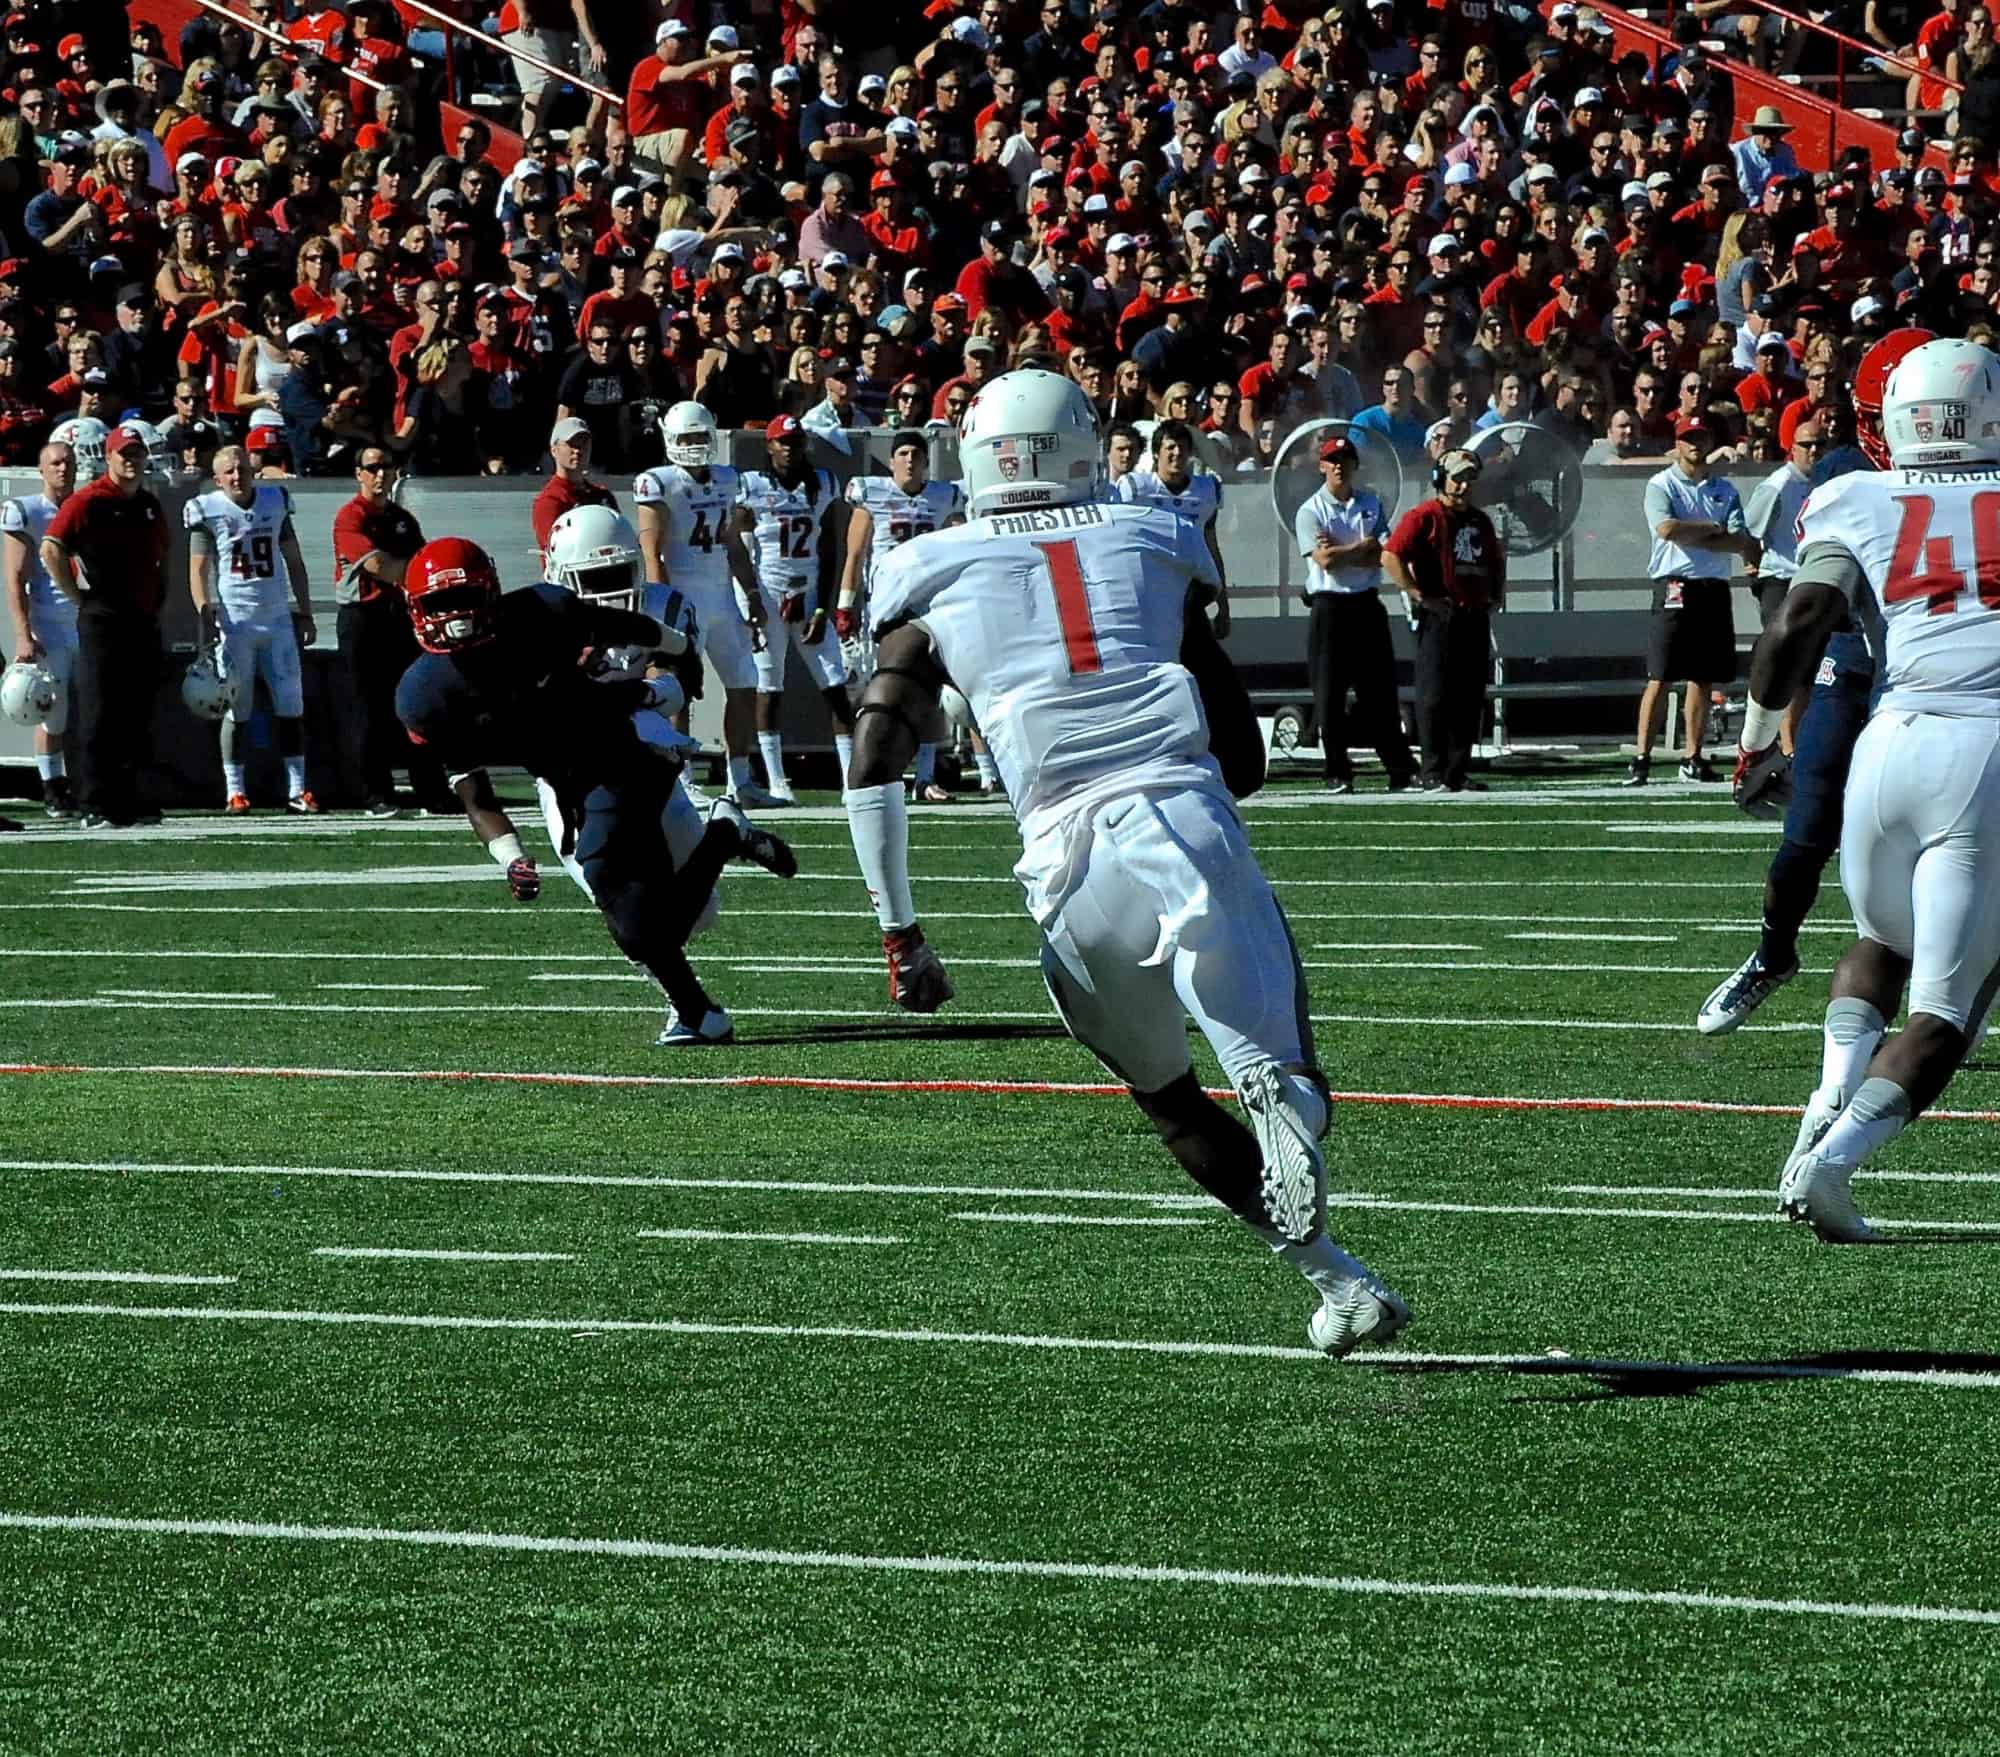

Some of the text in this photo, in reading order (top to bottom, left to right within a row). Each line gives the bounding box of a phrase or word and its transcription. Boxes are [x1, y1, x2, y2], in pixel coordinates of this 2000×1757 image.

[1945, 403, 1968, 418] ESF
[1941, 418, 1966, 441] 40
[1031, 436, 1055, 451] ESF
[1917, 450, 1962, 463] COUGARS
[1001, 489, 1051, 505] COUGARS
[778, 516, 814, 558] 12
[230, 535, 275, 581] 49
[1030, 536, 1105, 676] 1
